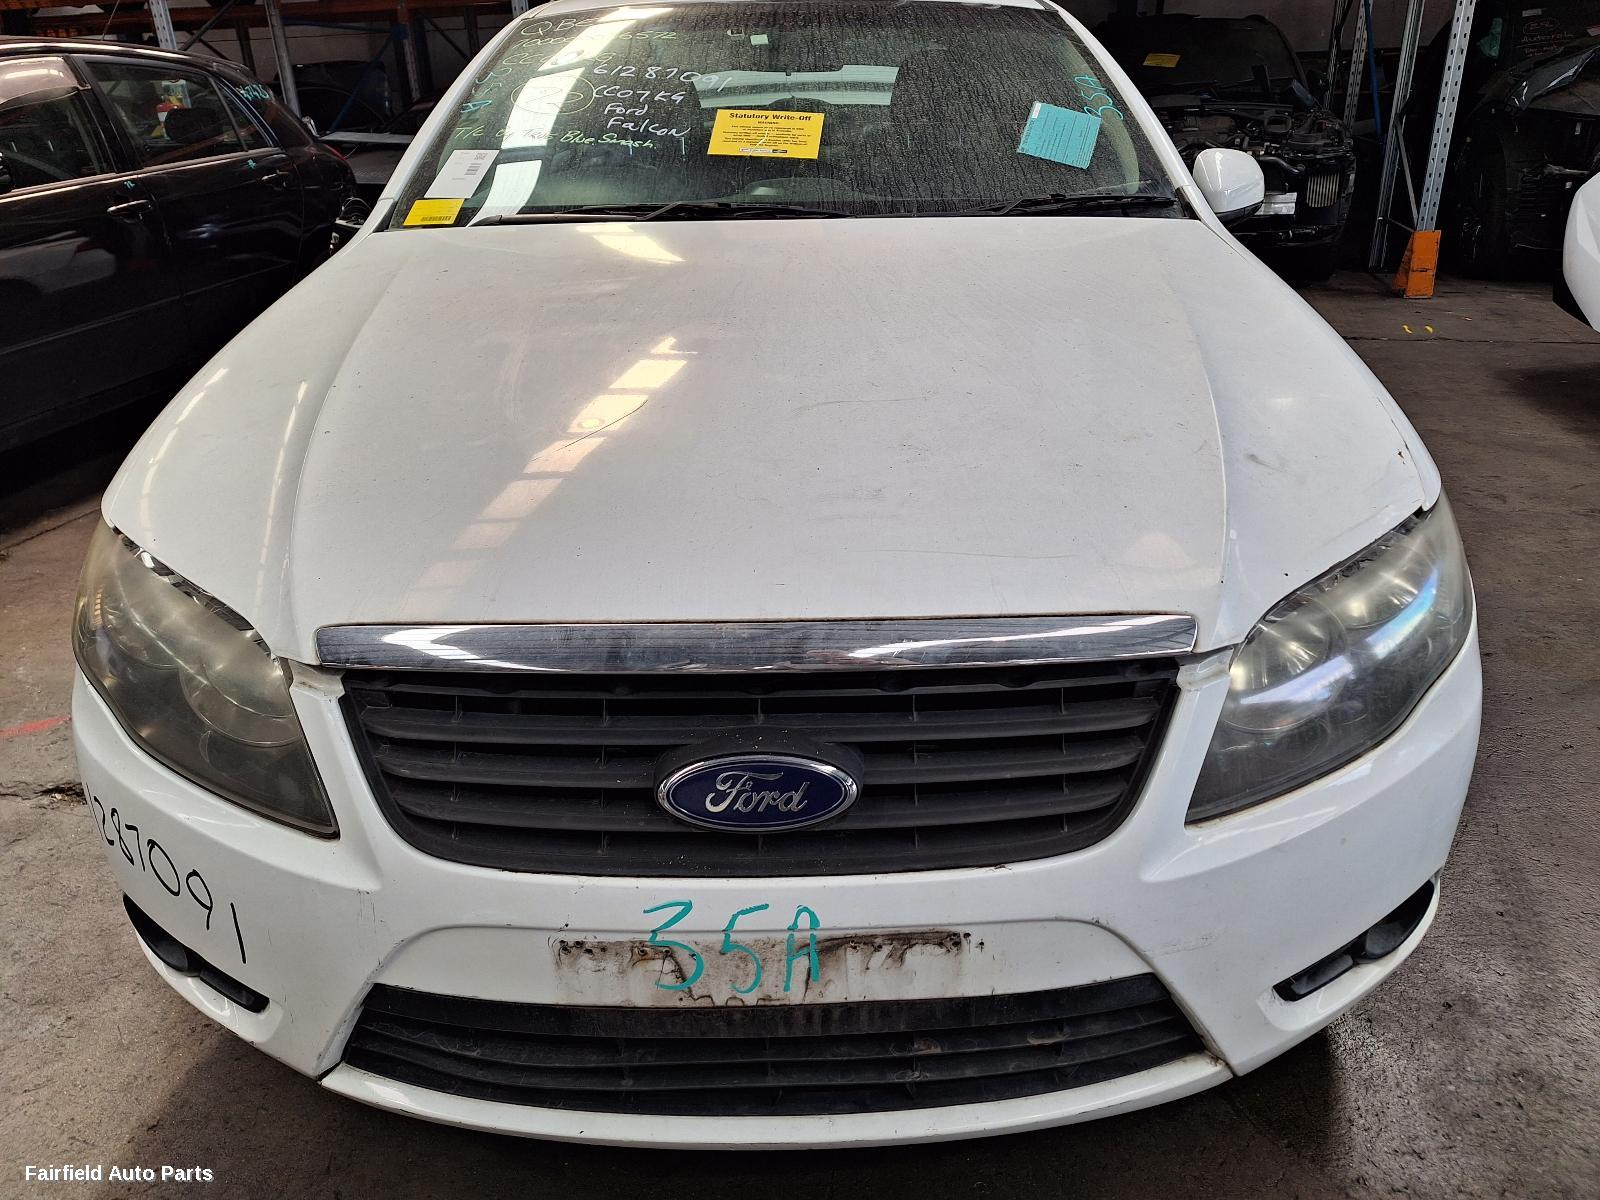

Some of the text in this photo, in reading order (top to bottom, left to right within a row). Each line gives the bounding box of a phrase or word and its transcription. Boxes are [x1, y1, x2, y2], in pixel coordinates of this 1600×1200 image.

[603, 102, 649, 116] Ford
[729, 112, 770, 120] Statutory
[606, 116, 692, 137] Falcon
[705, 771, 810, 813] Ford
[642, 899, 821, 994] 35A
